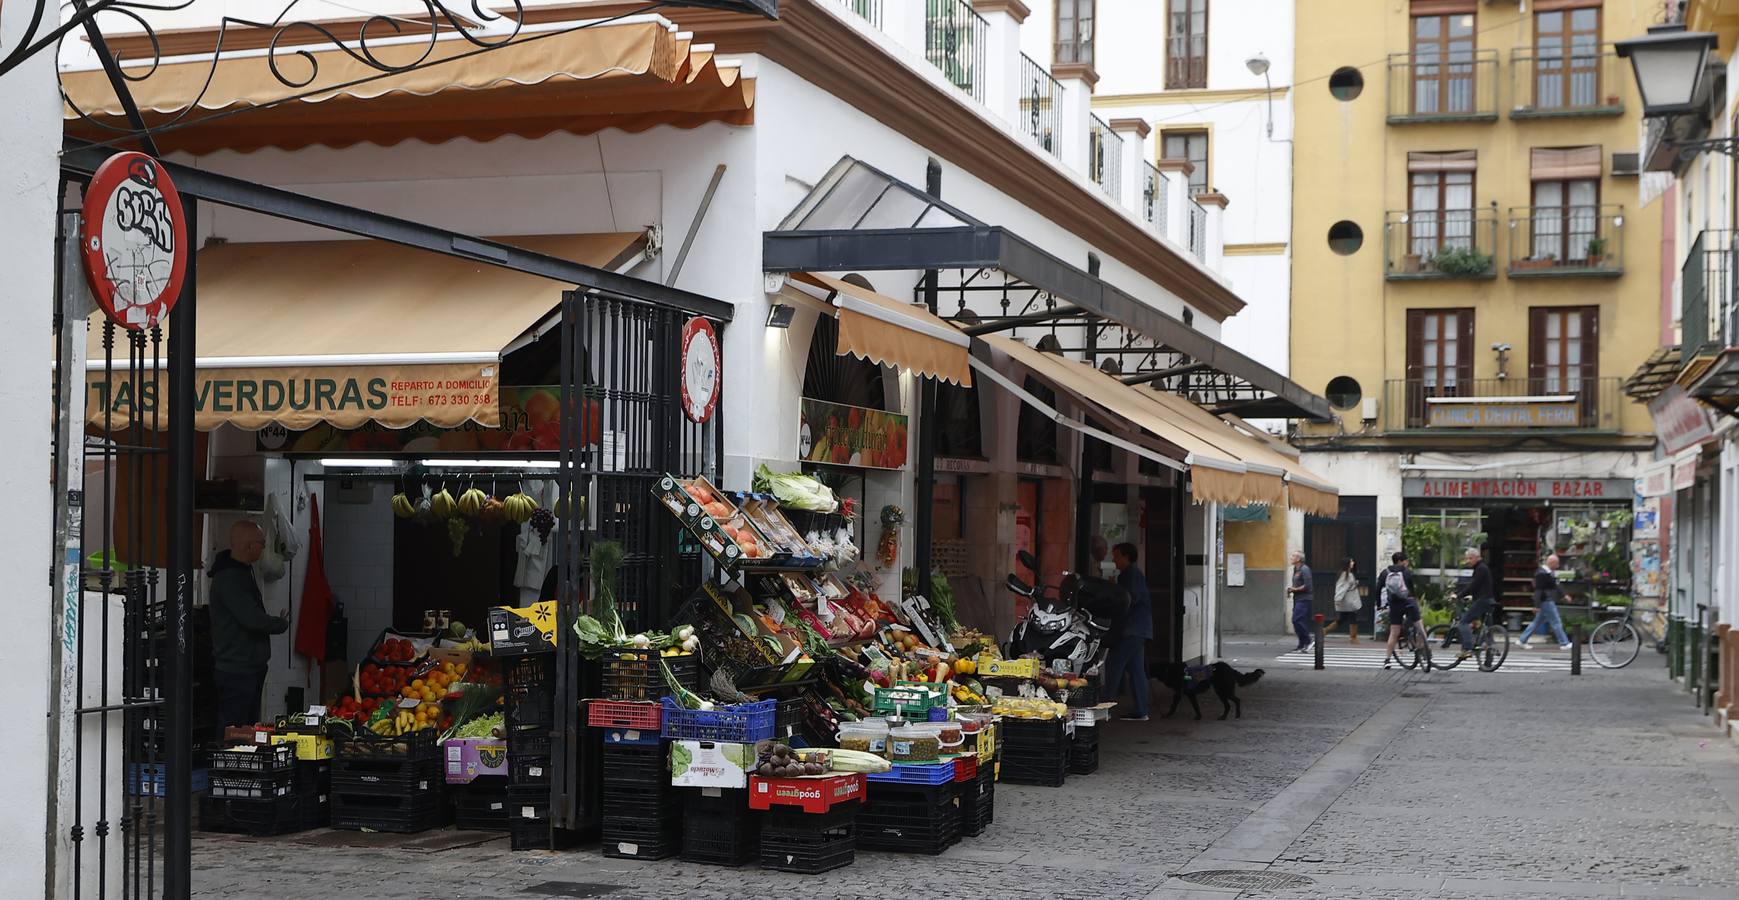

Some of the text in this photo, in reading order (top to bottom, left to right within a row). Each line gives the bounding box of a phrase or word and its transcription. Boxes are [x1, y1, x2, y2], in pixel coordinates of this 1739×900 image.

[391, 380, 491, 391] REPARTO A DOMICILIO
[194, 378, 388, 412] VERDURAS
[391, 395, 423, 406] TELF:
[428, 394, 447, 405] 673
[450, 394, 470, 405] 330
[1552, 480, 1604, 497] BAZAR
[776, 788, 821, 799] goodgreen
